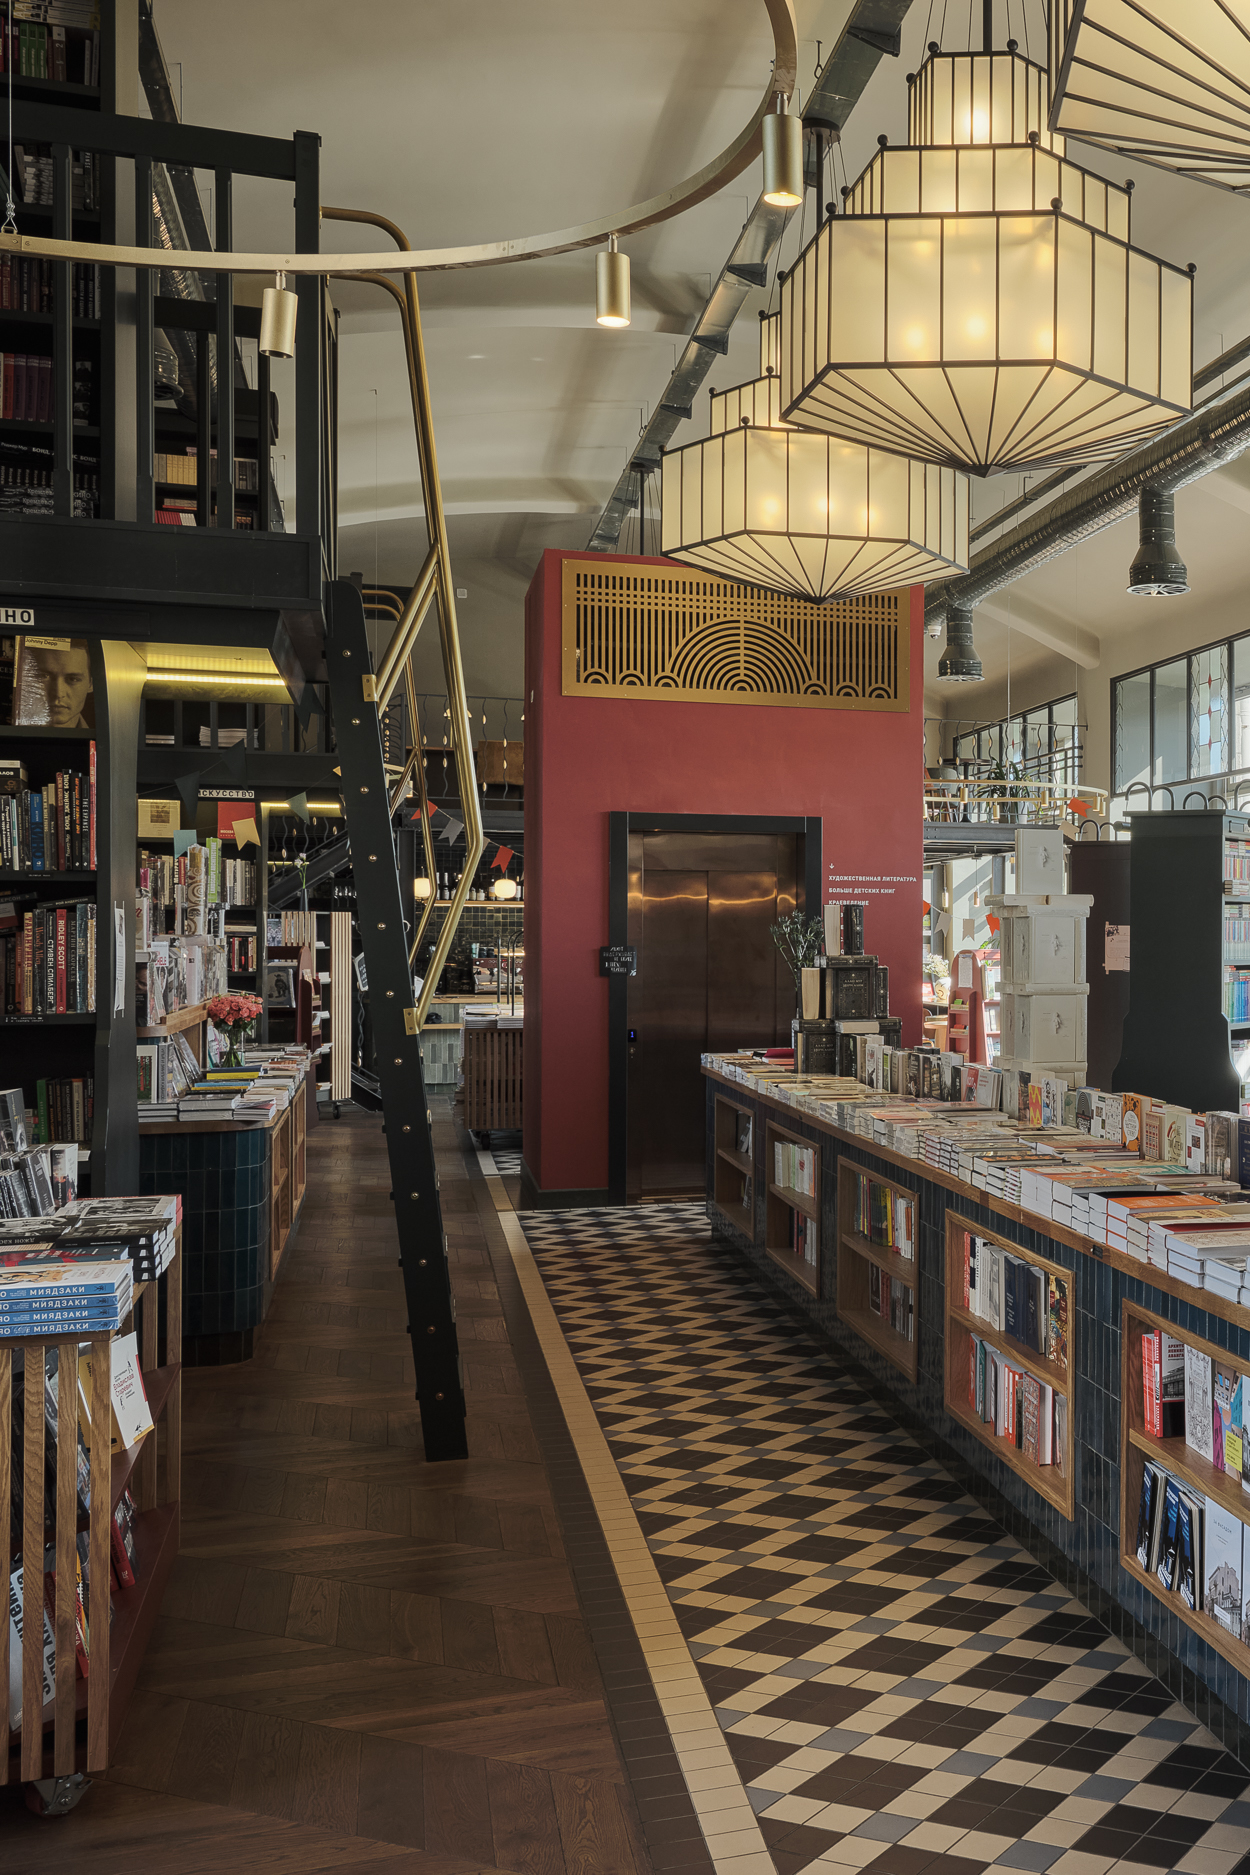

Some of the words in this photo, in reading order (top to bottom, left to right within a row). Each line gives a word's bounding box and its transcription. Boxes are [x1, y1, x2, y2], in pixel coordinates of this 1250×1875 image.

[0, 608, 32, 624] НО
[198, 790, 254, 798] СКУССТВО
[32, 822, 44, 860] КИНО
[34, 926, 43, 948] Woody
[36, 949, 44, 965] Allen
[30, 1286, 85, 1296] МИЯДЗАКИ
[32, 1299, 88, 1309] МИЯДЗАКИ
[33, 1311, 88, 1320] МИЯДЗАКИ
[33, 1323, 89, 1332] МИЯДЗАКИ
